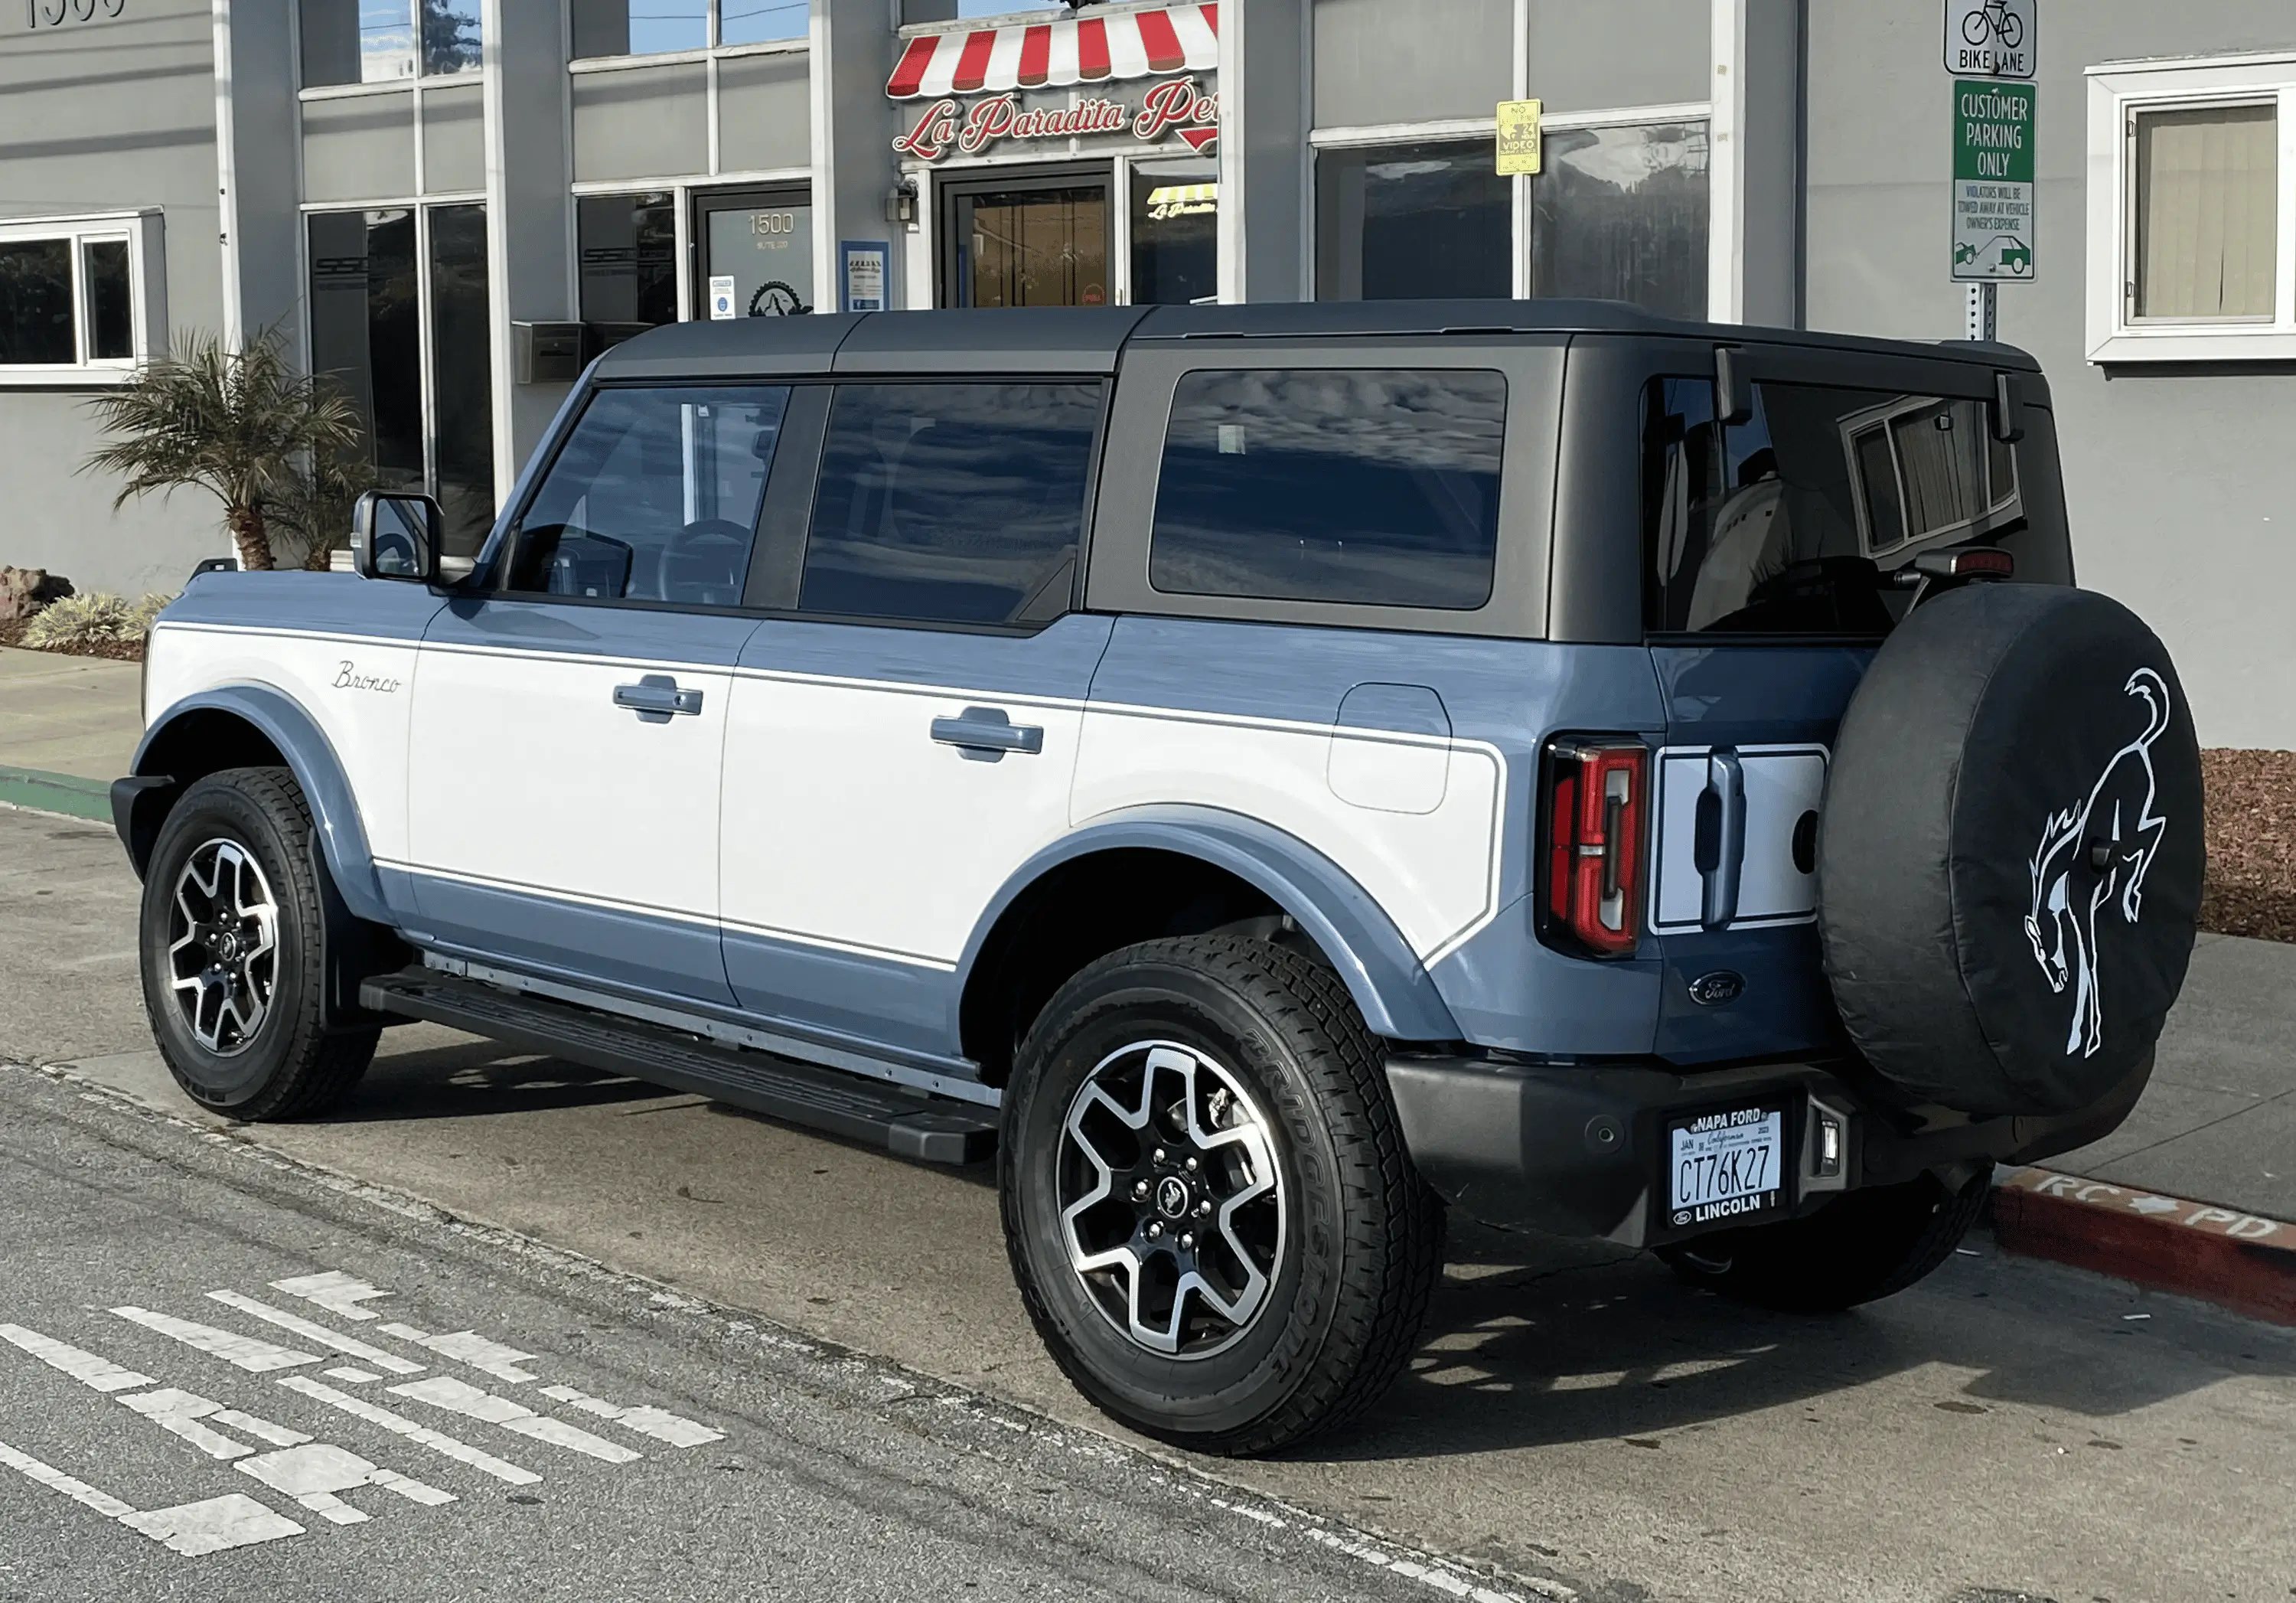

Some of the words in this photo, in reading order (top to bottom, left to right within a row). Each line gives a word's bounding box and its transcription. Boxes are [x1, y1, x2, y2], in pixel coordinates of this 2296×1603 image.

[1959, 49, 1990, 69] BIKE
[1994, 51, 2024, 72] LANE
[1961, 93, 2027, 121] CUSTOMER
[892, 98, 956, 159] La
[958, 92, 1126, 153] Paradita
[1966, 122, 2022, 149] PARKING
[1502, 139, 1534, 150] VIDEO
[1977, 151, 2011, 177] ONLY
[1965, 184, 1997, 199] VIOLATORS
[1998, 186, 2012, 199] WILL
[2014, 187, 2021, 200] BE
[1958, 200, 1978, 214] TOWED
[1979, 201, 1996, 214] AWAY
[1997, 201, 2004, 214] AT
[2005, 202, 2030, 215] VEHICLE
[748, 213, 794, 235] 1500
[1965, 217, 1993, 230] OWNER'S
[1994, 217, 2020, 230] EXPENSE
[331, 660, 403, 694] Bronco
[1704, 980, 1737, 1000] Ford
[1696, 1114, 1729, 1132] NAPA
[1730, 1108, 1761, 1127] FORD
[1679, 1144, 1770, 1204] CT76K27
[1695, 1194, 1761, 1223] LINCOLN
